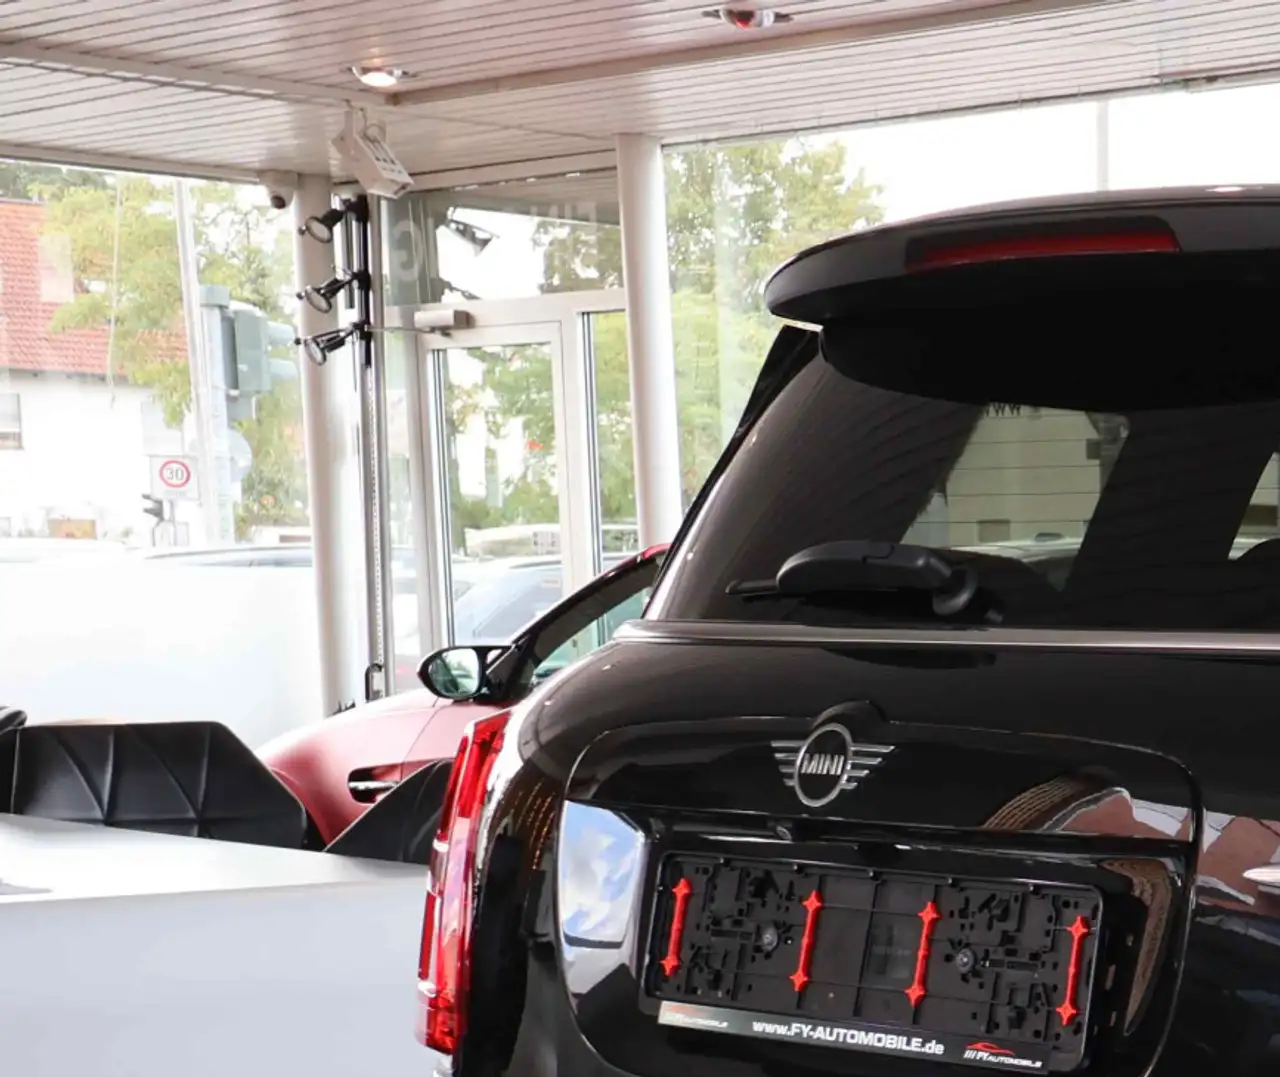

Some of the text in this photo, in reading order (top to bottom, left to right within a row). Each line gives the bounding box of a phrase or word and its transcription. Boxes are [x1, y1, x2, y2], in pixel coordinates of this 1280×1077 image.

[165, 466, 185, 481] 30
[801, 753, 845, 775] MINI
[752, 1018, 945, 1055] www.FY-AUTOMOBILE.de
